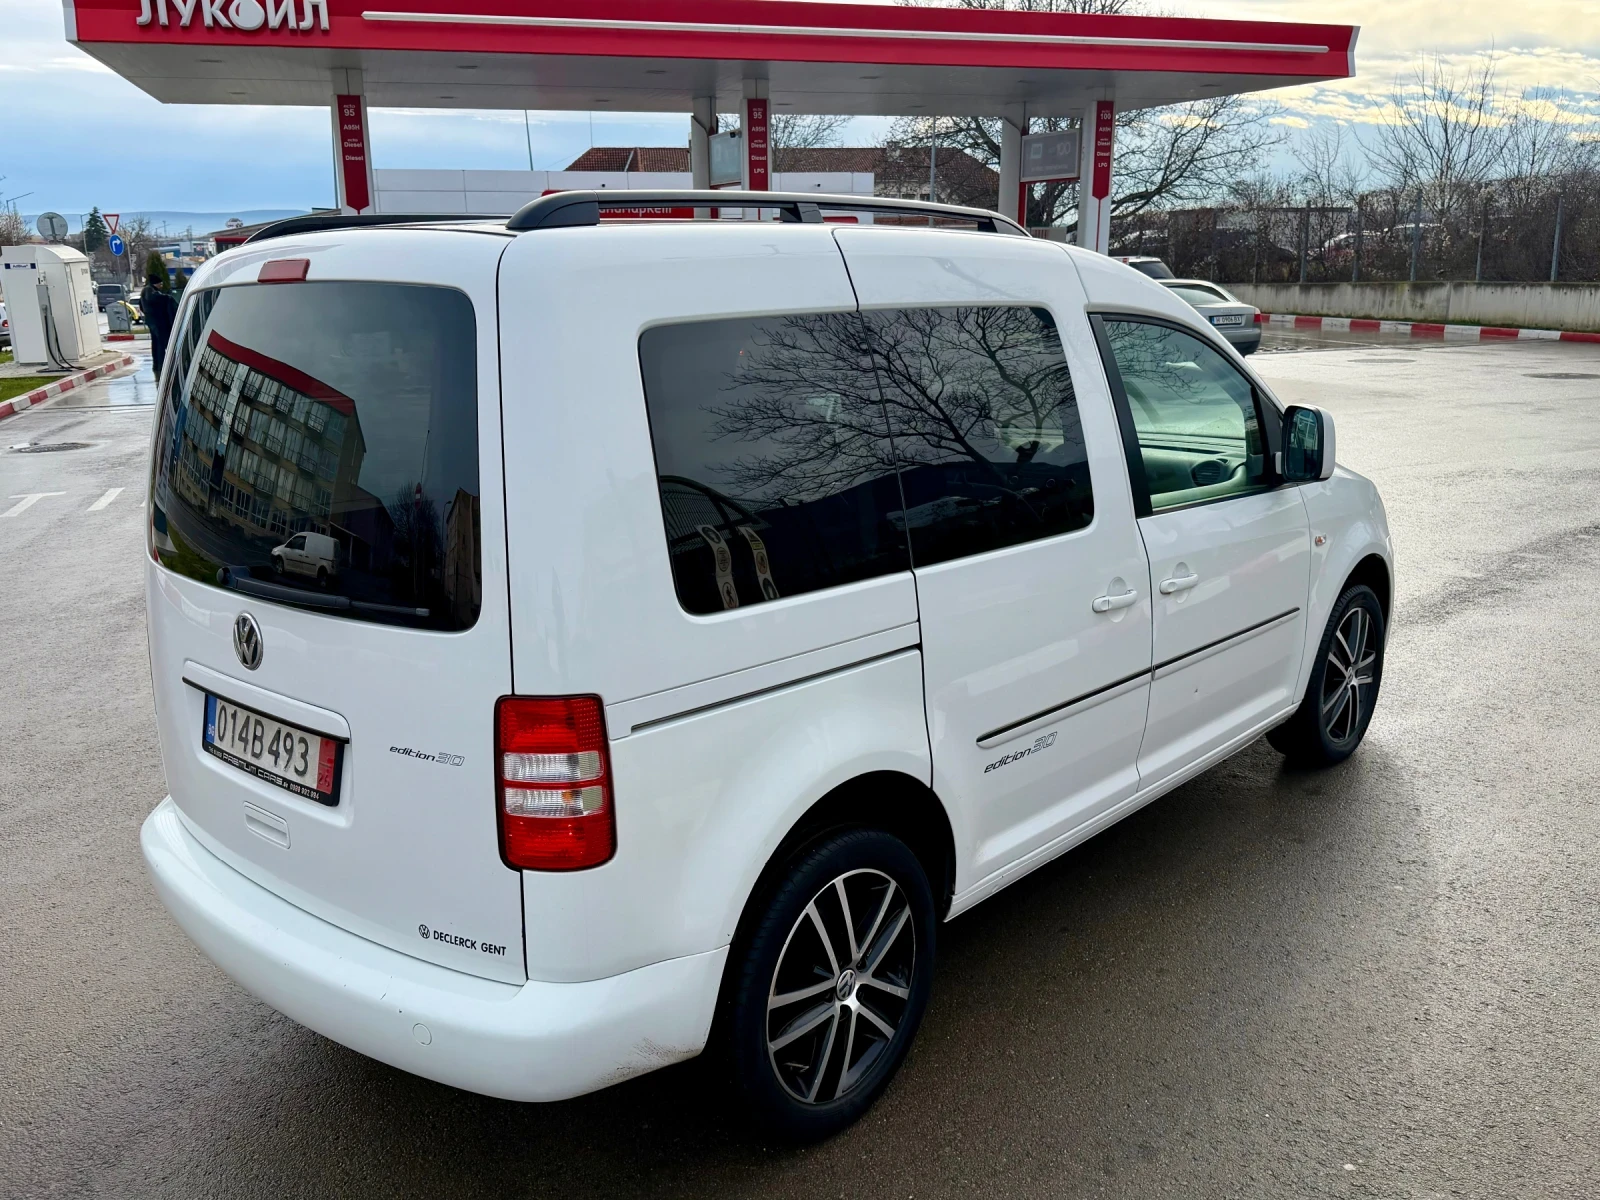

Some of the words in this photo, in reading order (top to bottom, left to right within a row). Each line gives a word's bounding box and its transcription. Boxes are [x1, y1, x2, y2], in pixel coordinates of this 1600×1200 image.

[344, 109, 355, 117] 95
[433, 930, 477, 950] DECLERCK
[480, 942, 507, 956] GENT
